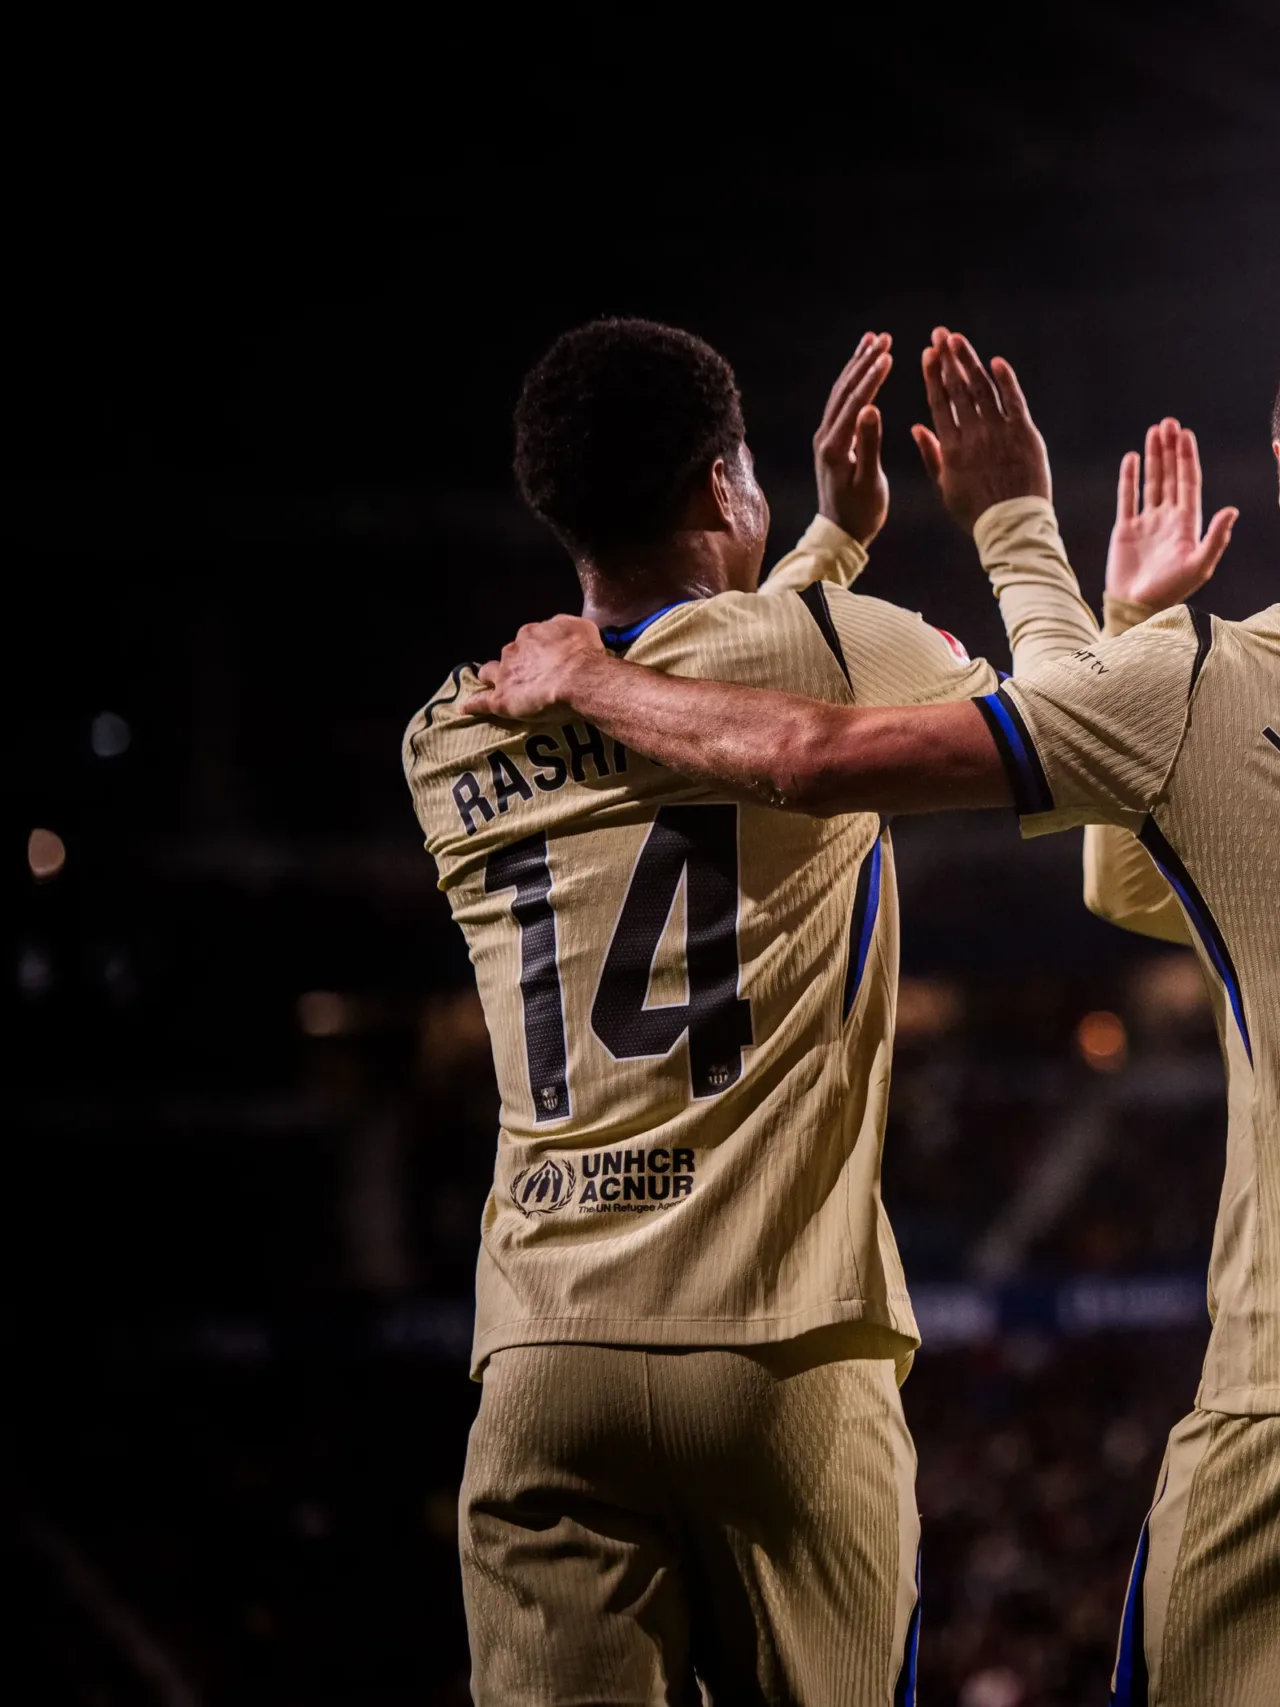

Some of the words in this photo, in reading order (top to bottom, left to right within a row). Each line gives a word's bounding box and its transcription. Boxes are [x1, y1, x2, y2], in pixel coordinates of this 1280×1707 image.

[484, 802, 757, 1127] 14
[582, 1148, 696, 1178] UNHCR
[579, 1175, 694, 1204] ACNUR
[578, 1205, 595, 1214] The
[596, 1203, 611, 1213] UN
[613, 1202, 656, 1214] Refugee
